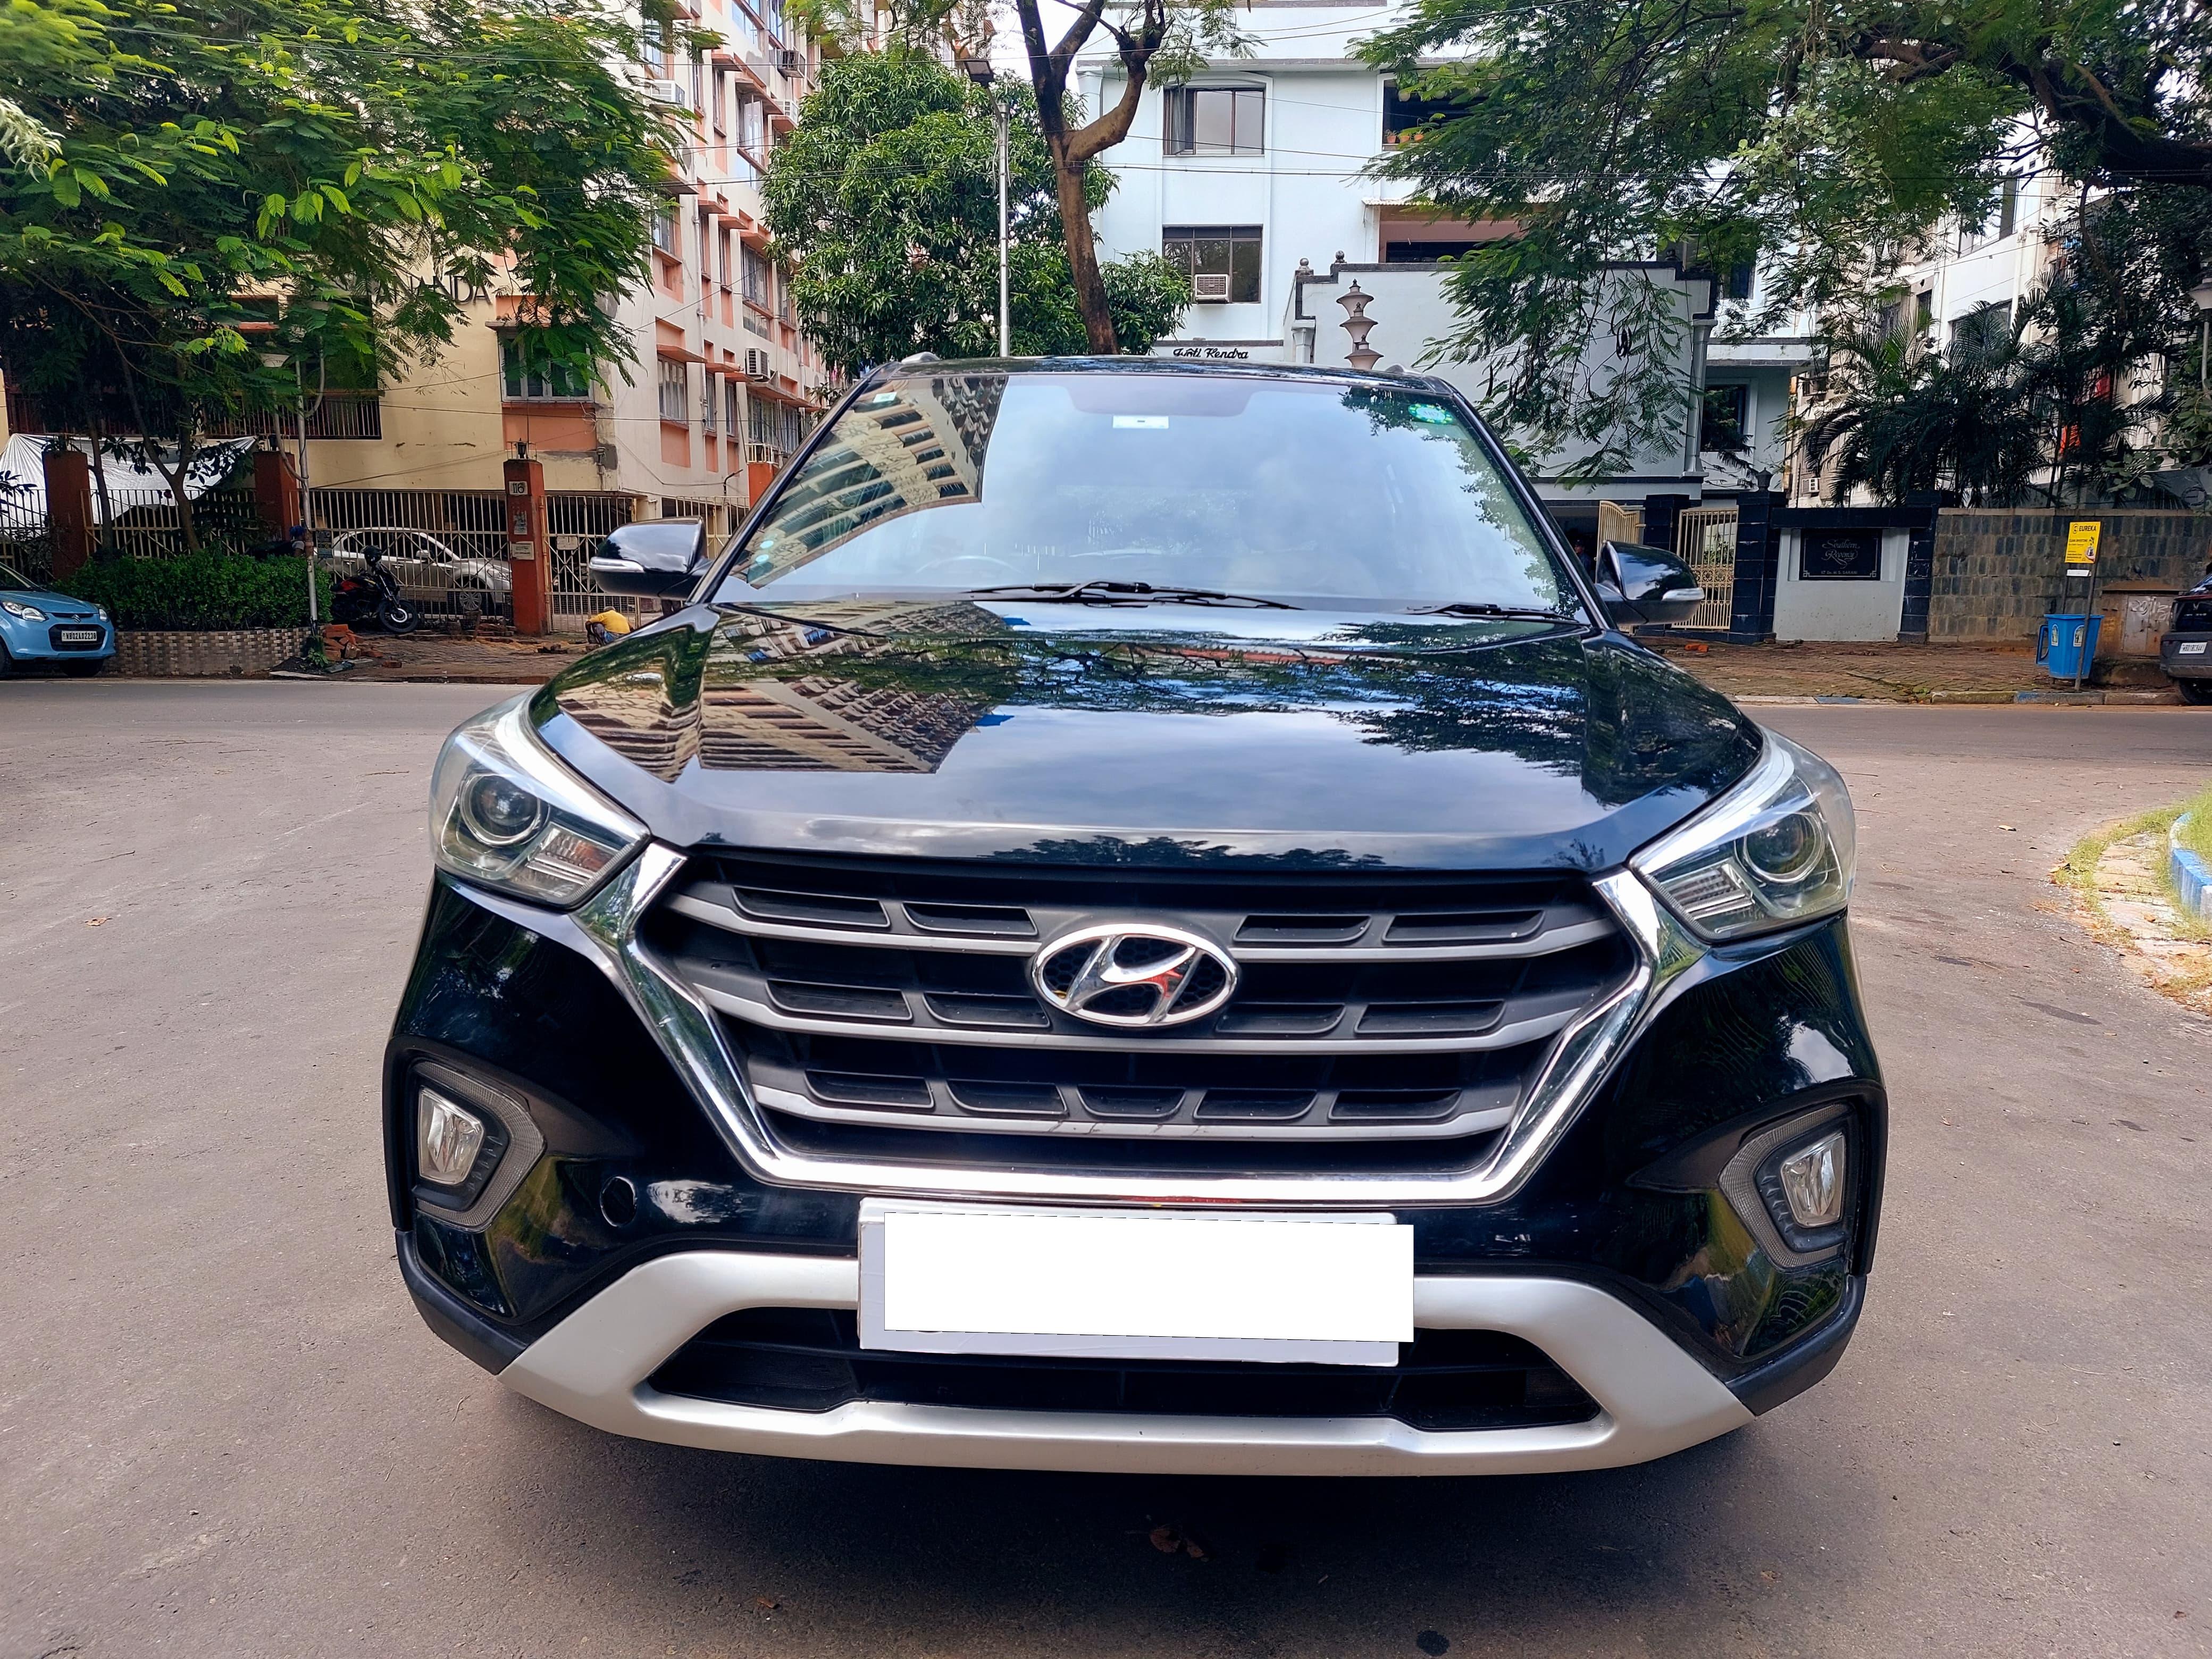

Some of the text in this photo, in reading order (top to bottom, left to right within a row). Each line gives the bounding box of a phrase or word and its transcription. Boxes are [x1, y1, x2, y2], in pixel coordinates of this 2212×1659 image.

[1204, 348, 1249, 359] Kendra
[513, 482, 525, 493] 116
[1822, 538, 1861, 549] Southern
